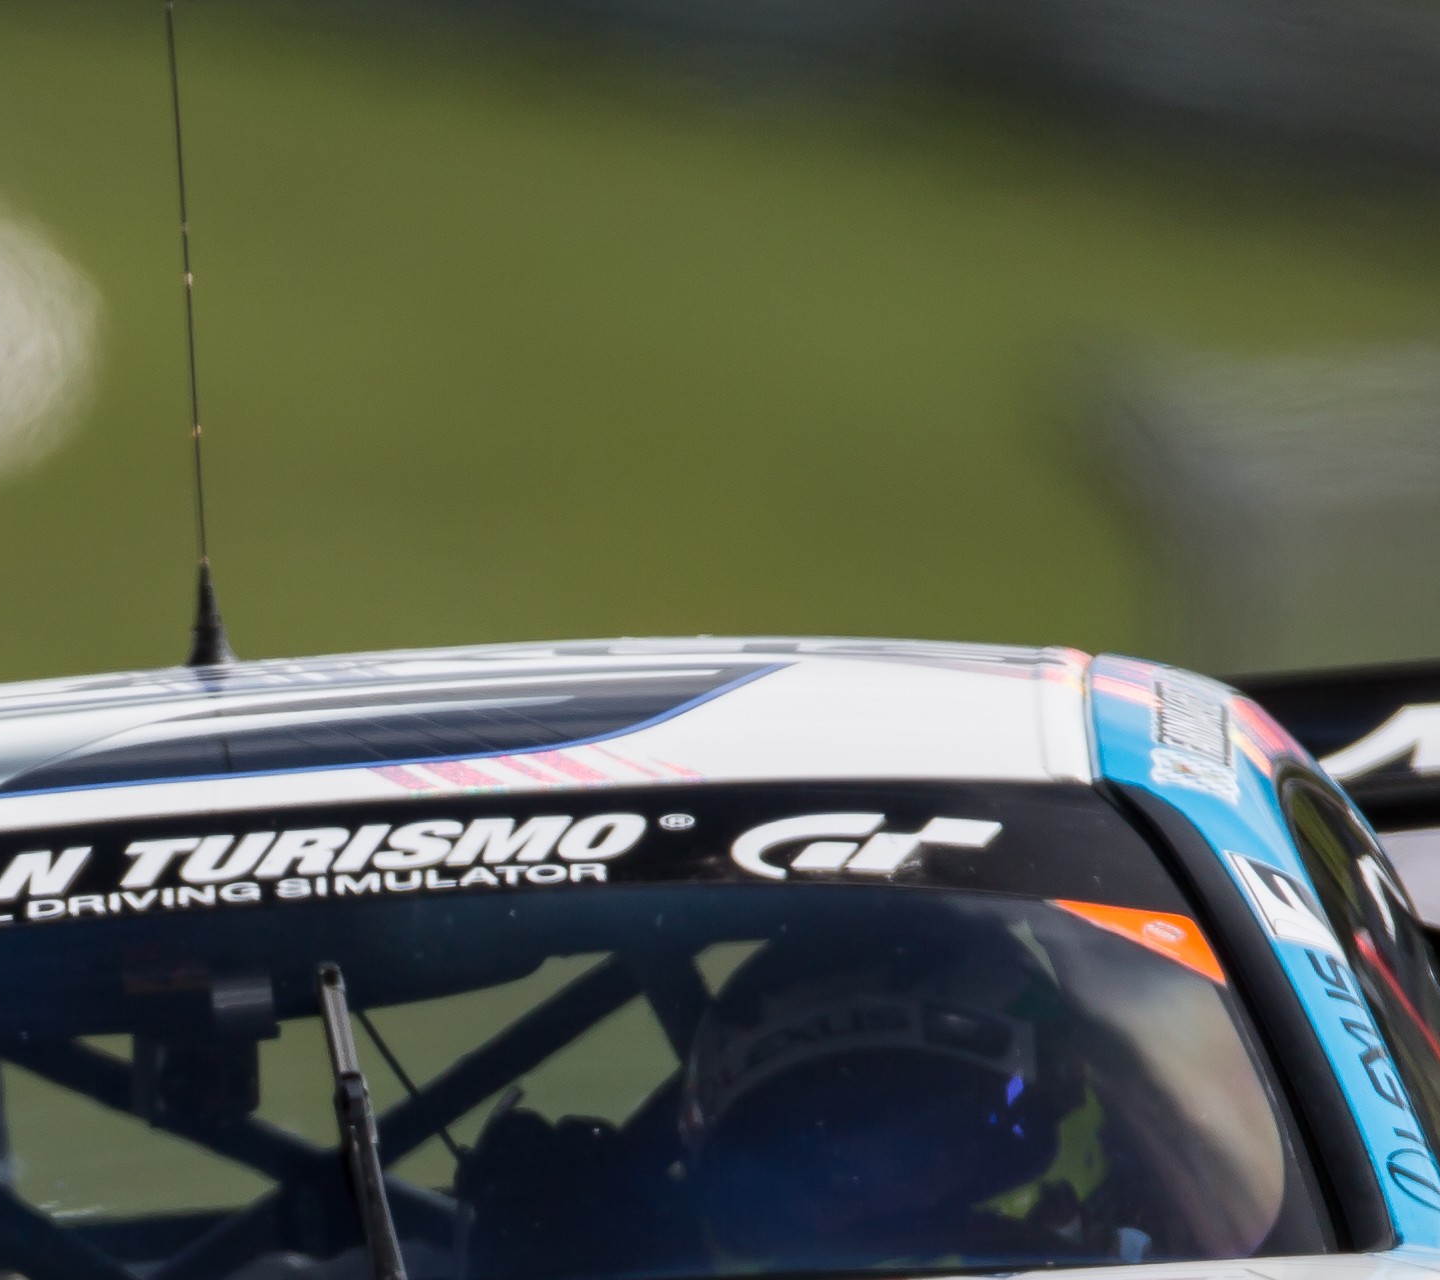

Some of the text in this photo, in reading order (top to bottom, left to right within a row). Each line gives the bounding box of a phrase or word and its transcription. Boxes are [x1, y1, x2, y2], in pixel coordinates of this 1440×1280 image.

[119, 812, 648, 889] TURISMO
[26, 882, 263, 922] DRIVING
[275, 862, 608, 899] SIMULATOR
